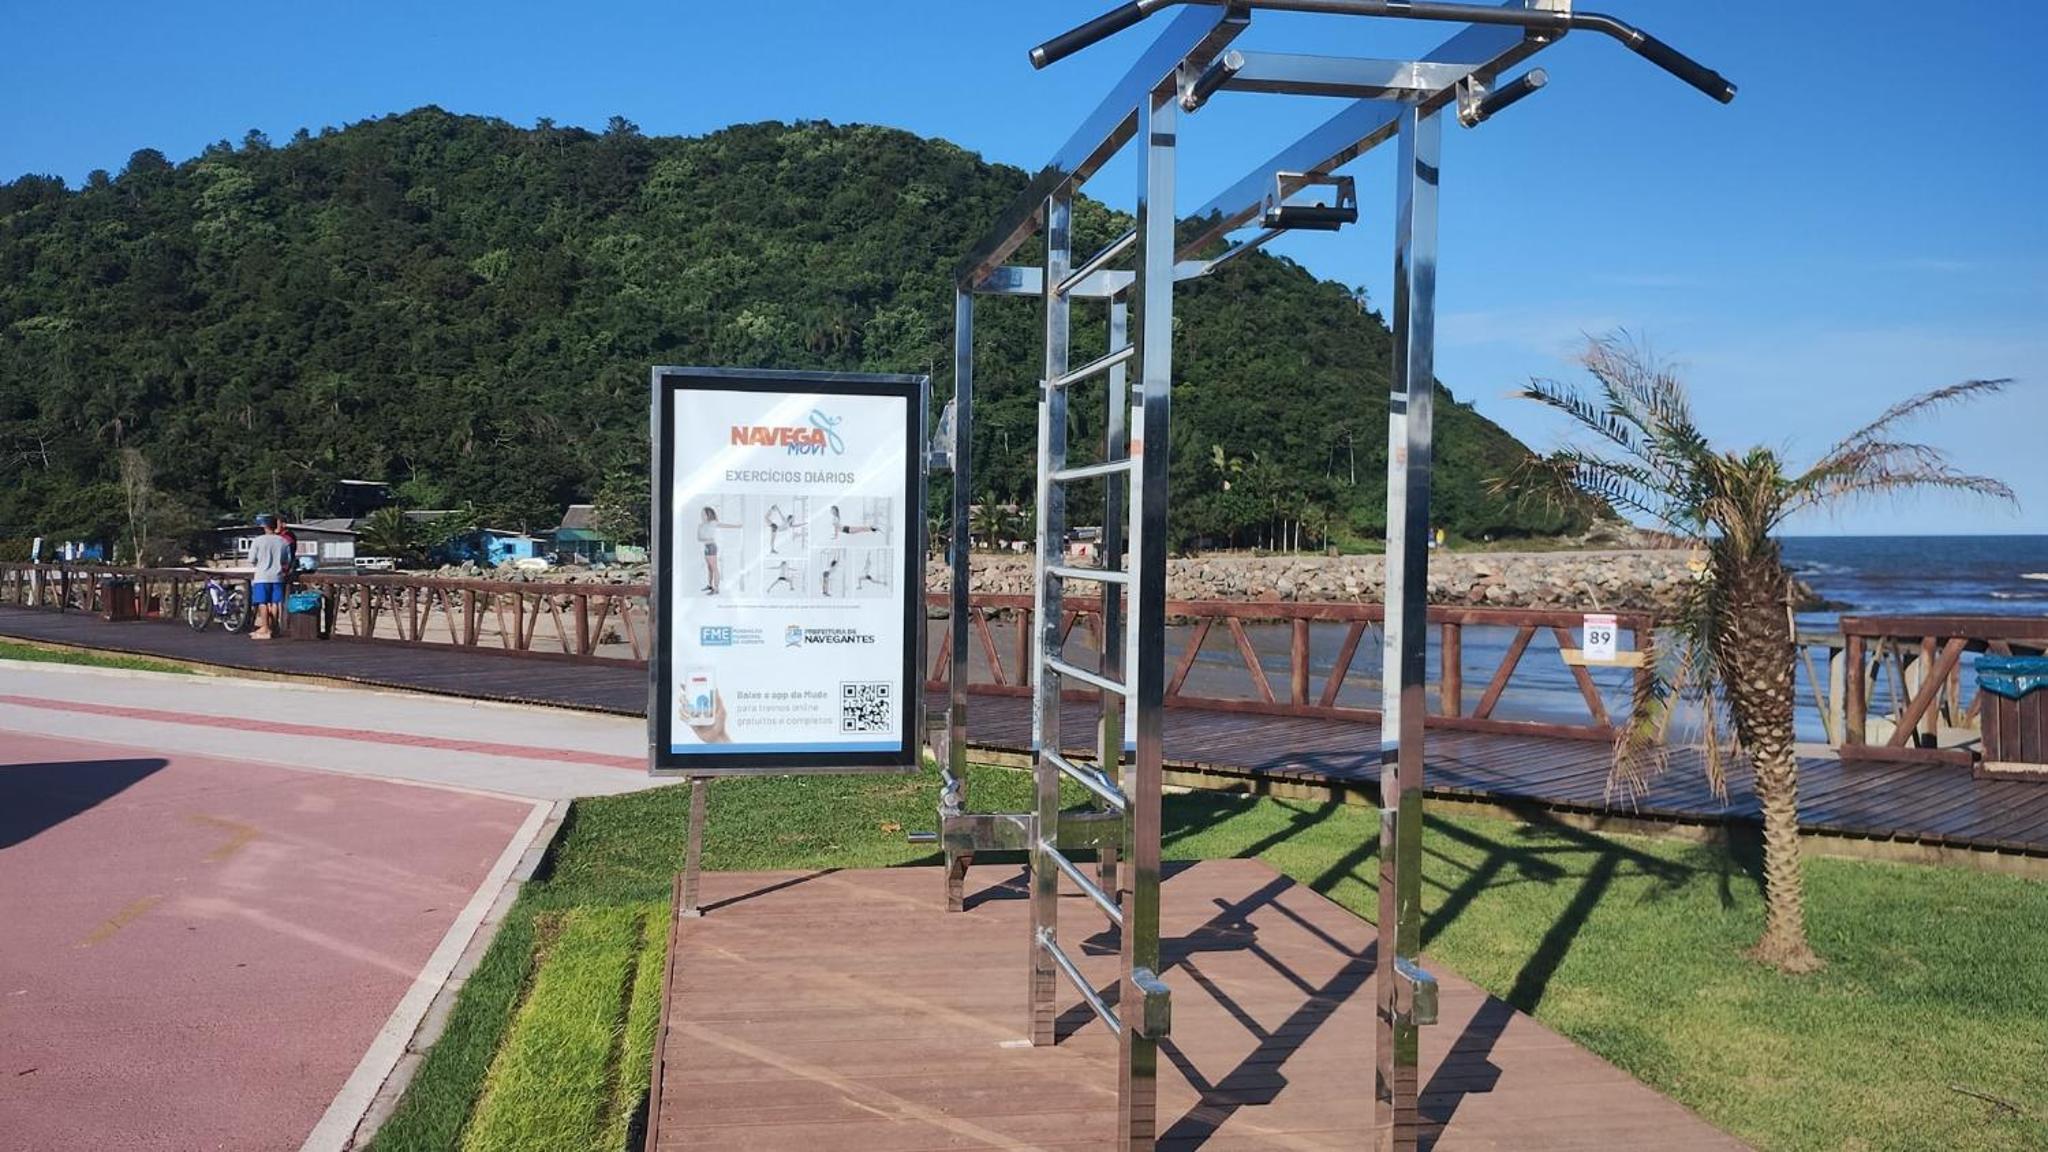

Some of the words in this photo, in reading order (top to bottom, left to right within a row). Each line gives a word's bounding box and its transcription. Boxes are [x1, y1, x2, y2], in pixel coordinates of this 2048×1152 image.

[731, 426, 827, 447] NAVEGA
[725, 467, 802, 483] EXERCÍCIOS
[804, 469, 855, 484] DIÁRIOS
[703, 628, 730, 640] FME
[804, 635, 875, 644] NAVEGANTES
[1590, 631, 1611, 645] 89
